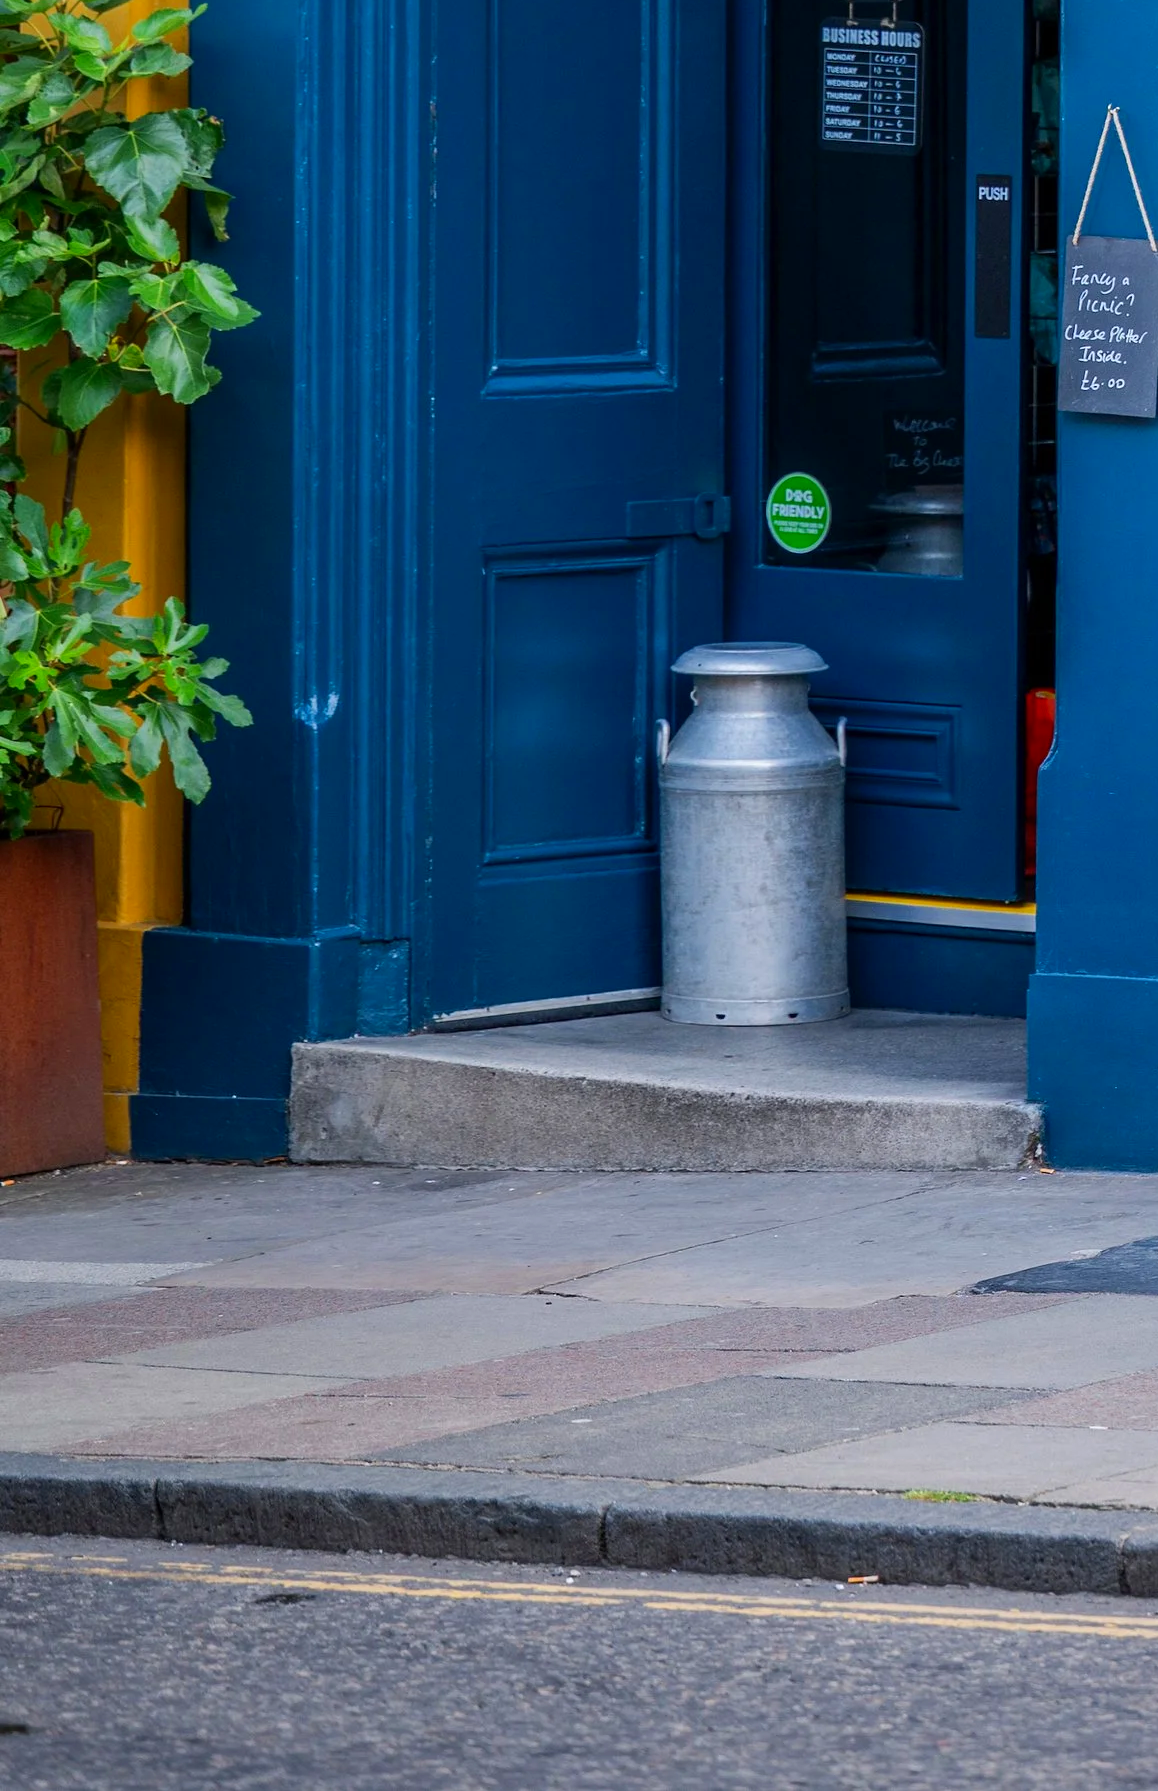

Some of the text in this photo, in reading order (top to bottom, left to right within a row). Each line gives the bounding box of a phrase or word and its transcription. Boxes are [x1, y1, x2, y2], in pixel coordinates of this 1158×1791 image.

[822, 27, 921, 48] BUSINESS HOURS
[826, 53, 856, 62] MONDAY
[826, 65, 858, 75] TUESDAY
[826, 78, 868, 88] WEDNESDAY
[826, 91, 862, 101] THURSDAY
[825, 104, 850, 114] FRIDAY
[825, 117, 861, 127] SATURDAY
[824, 130, 853, 140] SUNDAY
[978, 186, 1009, 201] PUSH
[1071, 265, 1130, 294] Fancy a
[1065, 324, 1148, 344] Cheese Platter
[1080, 370, 1126, 391] £6.00
[772, 502, 826, 520] FRIENDLY
